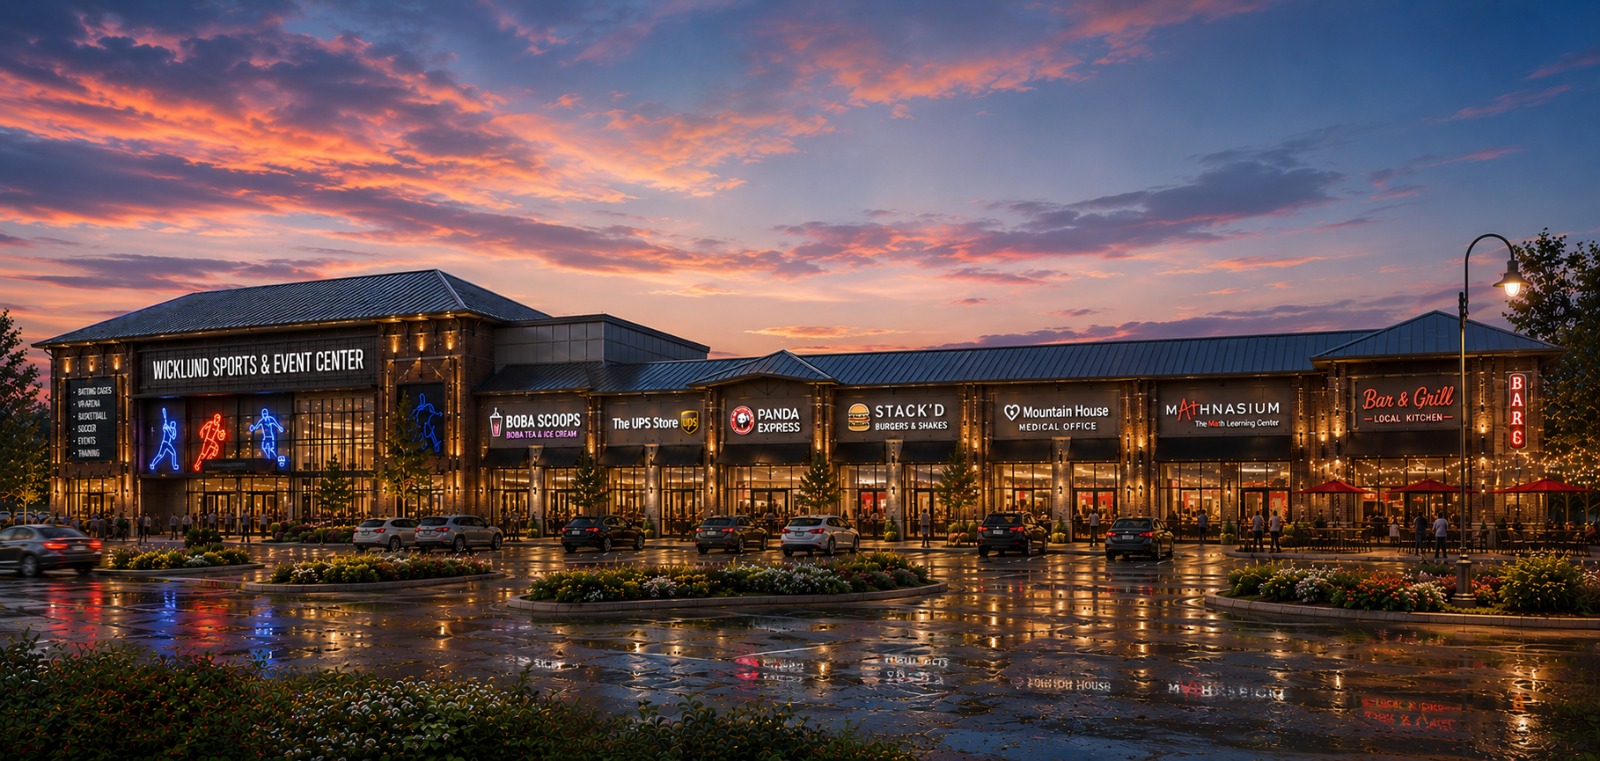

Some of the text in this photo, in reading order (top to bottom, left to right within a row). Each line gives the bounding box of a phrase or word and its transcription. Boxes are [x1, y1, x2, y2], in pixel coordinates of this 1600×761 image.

[153, 349, 364, 380] WICKLUND SPORTS & EVENT CENTER
[78, 386, 112, 396] BATTING CAGES
[1362, 386, 1454, 410] Bar & Grill
[758, 408, 799, 420] PANDA
[875, 403, 944, 418] STACK'D
[1023, 404, 1109, 418] Mountain House
[78, 411, 107, 421] BASKETBALL
[506, 413, 581, 428] BOBA SCOOPS
[1374, 413, 1443, 423] LOCAL KITCHEN
[78, 424, 97, 433] SOCCER
[612, 417, 679, 430] The UPS Store
[682, 417, 698, 430] ups
[758, 422, 800, 433] EXPRESS
[875, 421, 948, 430] BURGERS & SHAKES
[1018, 422, 1097, 431] MEDICAL OFFICE
[1195, 419, 1279, 429] The Math Learning Center
[506, 430, 577, 439] BOBA TEA & ICE CREAM
[78, 436, 96, 445] EVENTS
[78, 449, 100, 458] TRAINING
